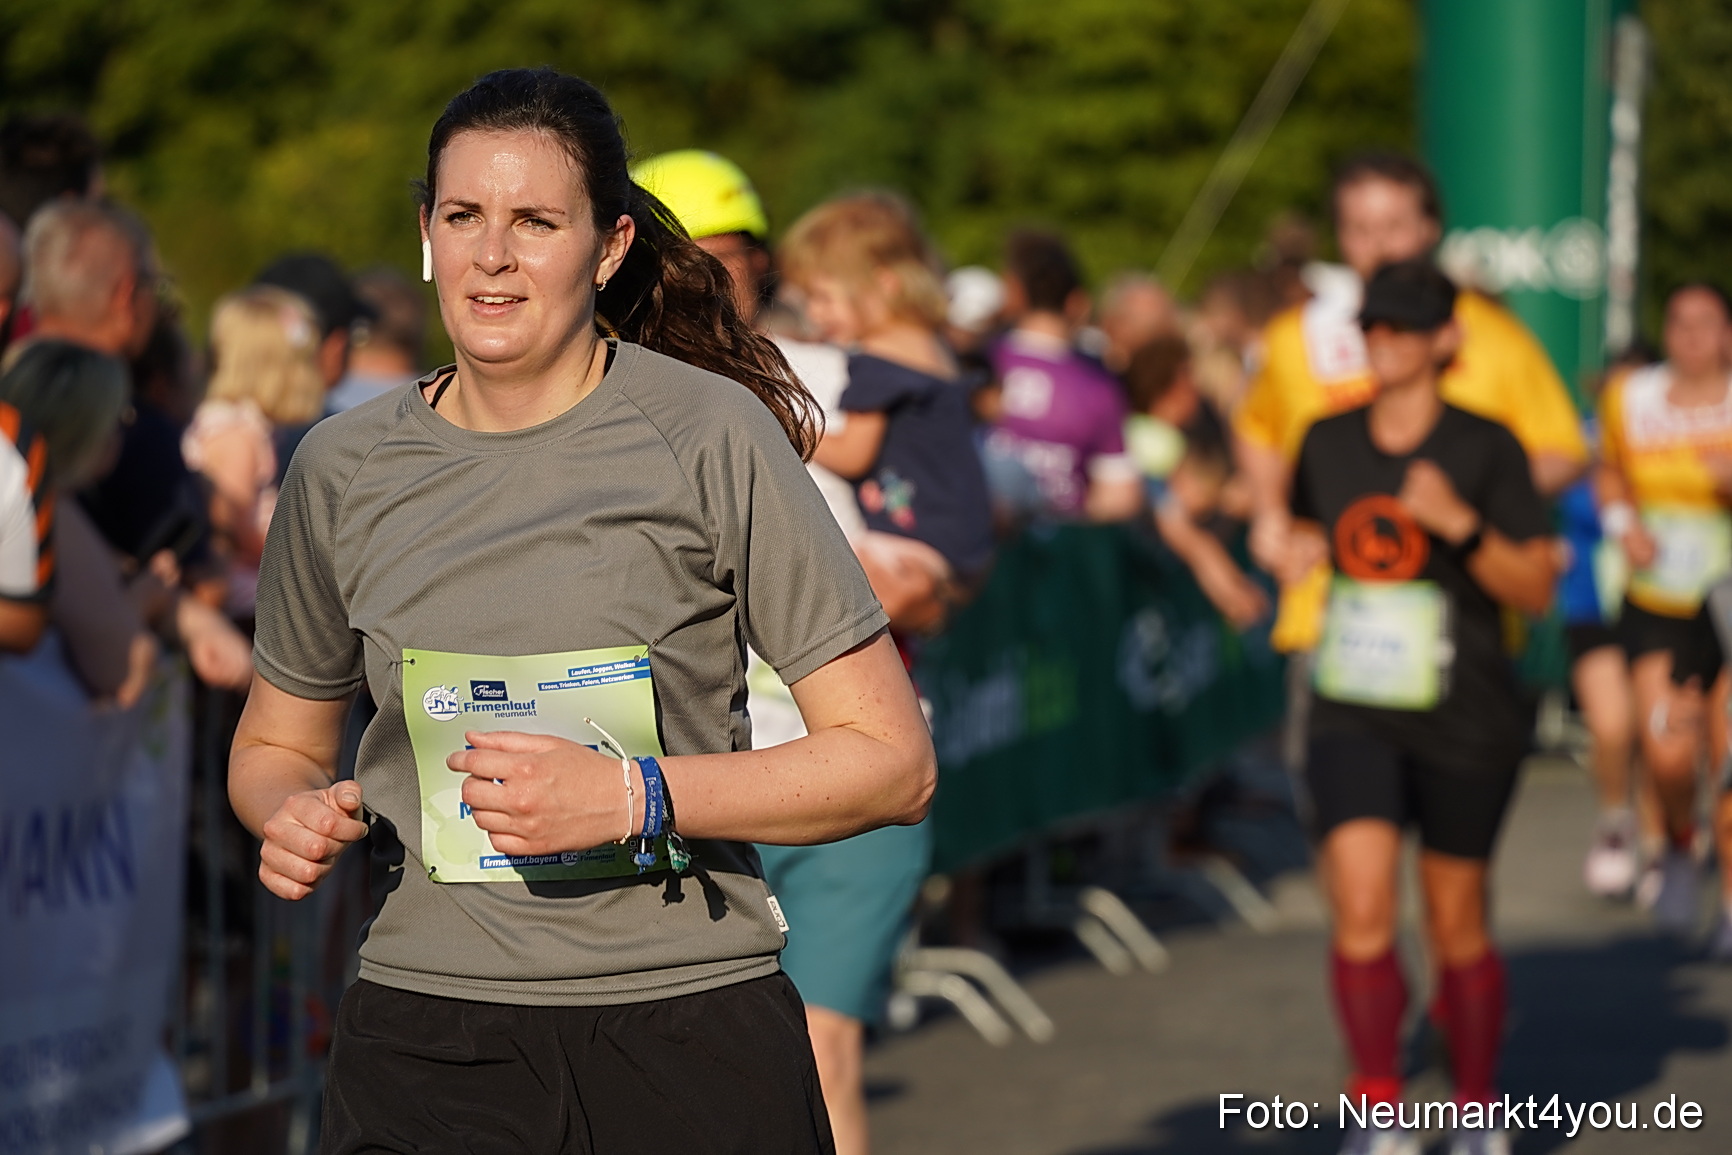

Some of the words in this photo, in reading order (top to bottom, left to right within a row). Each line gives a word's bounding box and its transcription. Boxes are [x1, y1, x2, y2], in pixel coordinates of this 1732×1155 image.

[614, 662, 636, 670] Walken
[601, 674, 635, 683] Netzwerken
[473, 685, 505, 696] Fischer
[464, 699, 536, 712] Firmenlauf
[495, 710, 537, 718] neumarkt
[483, 855, 558, 867] firmenlauf.bayern
